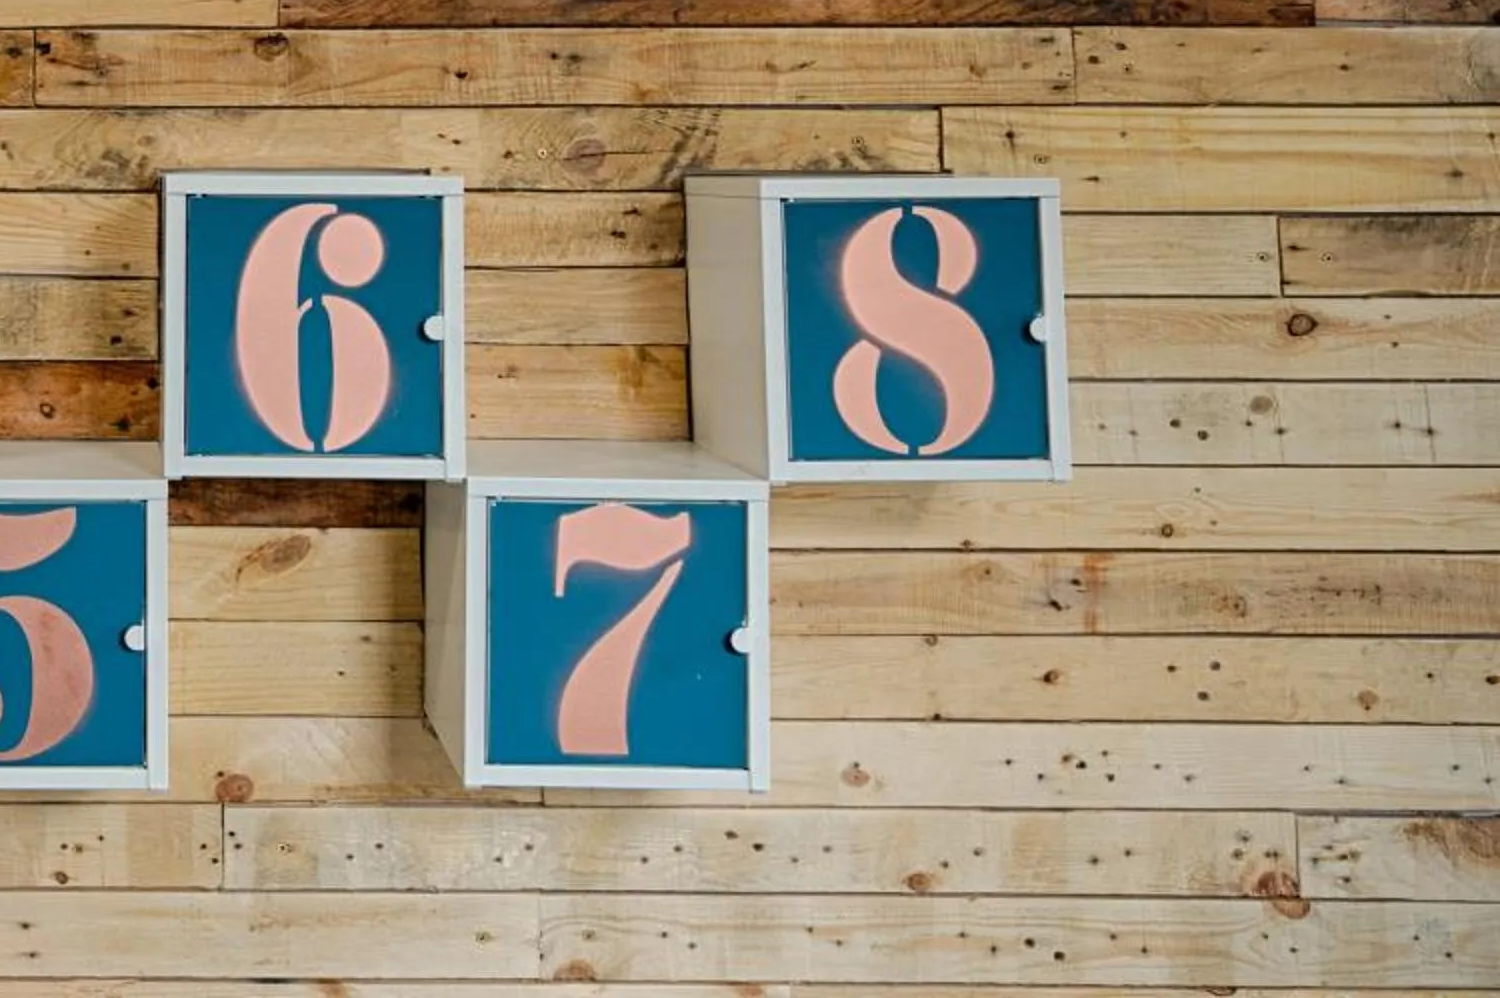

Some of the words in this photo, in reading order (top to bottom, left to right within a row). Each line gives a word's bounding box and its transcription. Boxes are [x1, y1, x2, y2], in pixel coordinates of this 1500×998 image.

[235, 202, 392, 453] 6
[832, 206, 995, 456] 8
[553, 505, 692, 756] 7
